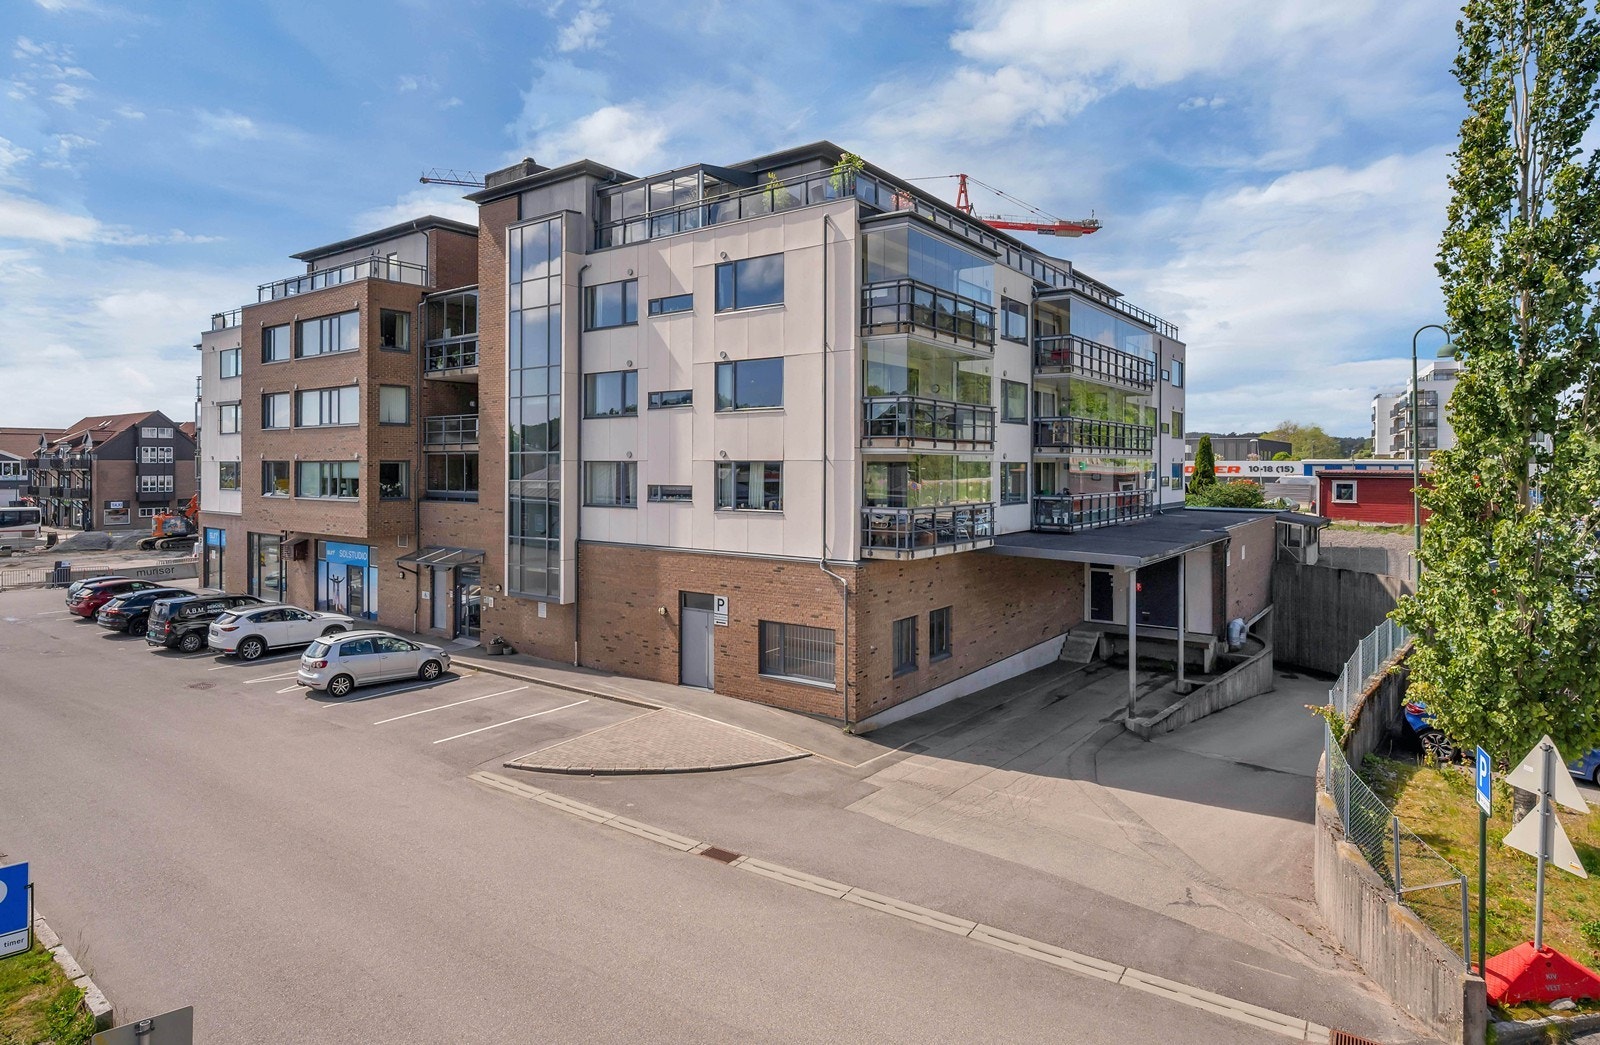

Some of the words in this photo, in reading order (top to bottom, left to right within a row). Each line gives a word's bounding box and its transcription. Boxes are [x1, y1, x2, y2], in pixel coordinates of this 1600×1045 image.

[1249, 465, 1273, 473] 10-18
[1275, 465, 1295, 474] (15)
[339, 549, 368, 560] SOLSTUDIO
[136, 567, 175, 577] murisør
[717, 598, 725, 611] P
[1479, 754, 1487, 787] P
[4, 938, 25, 948] timer
[1545, 984, 1561, 992] VEST
